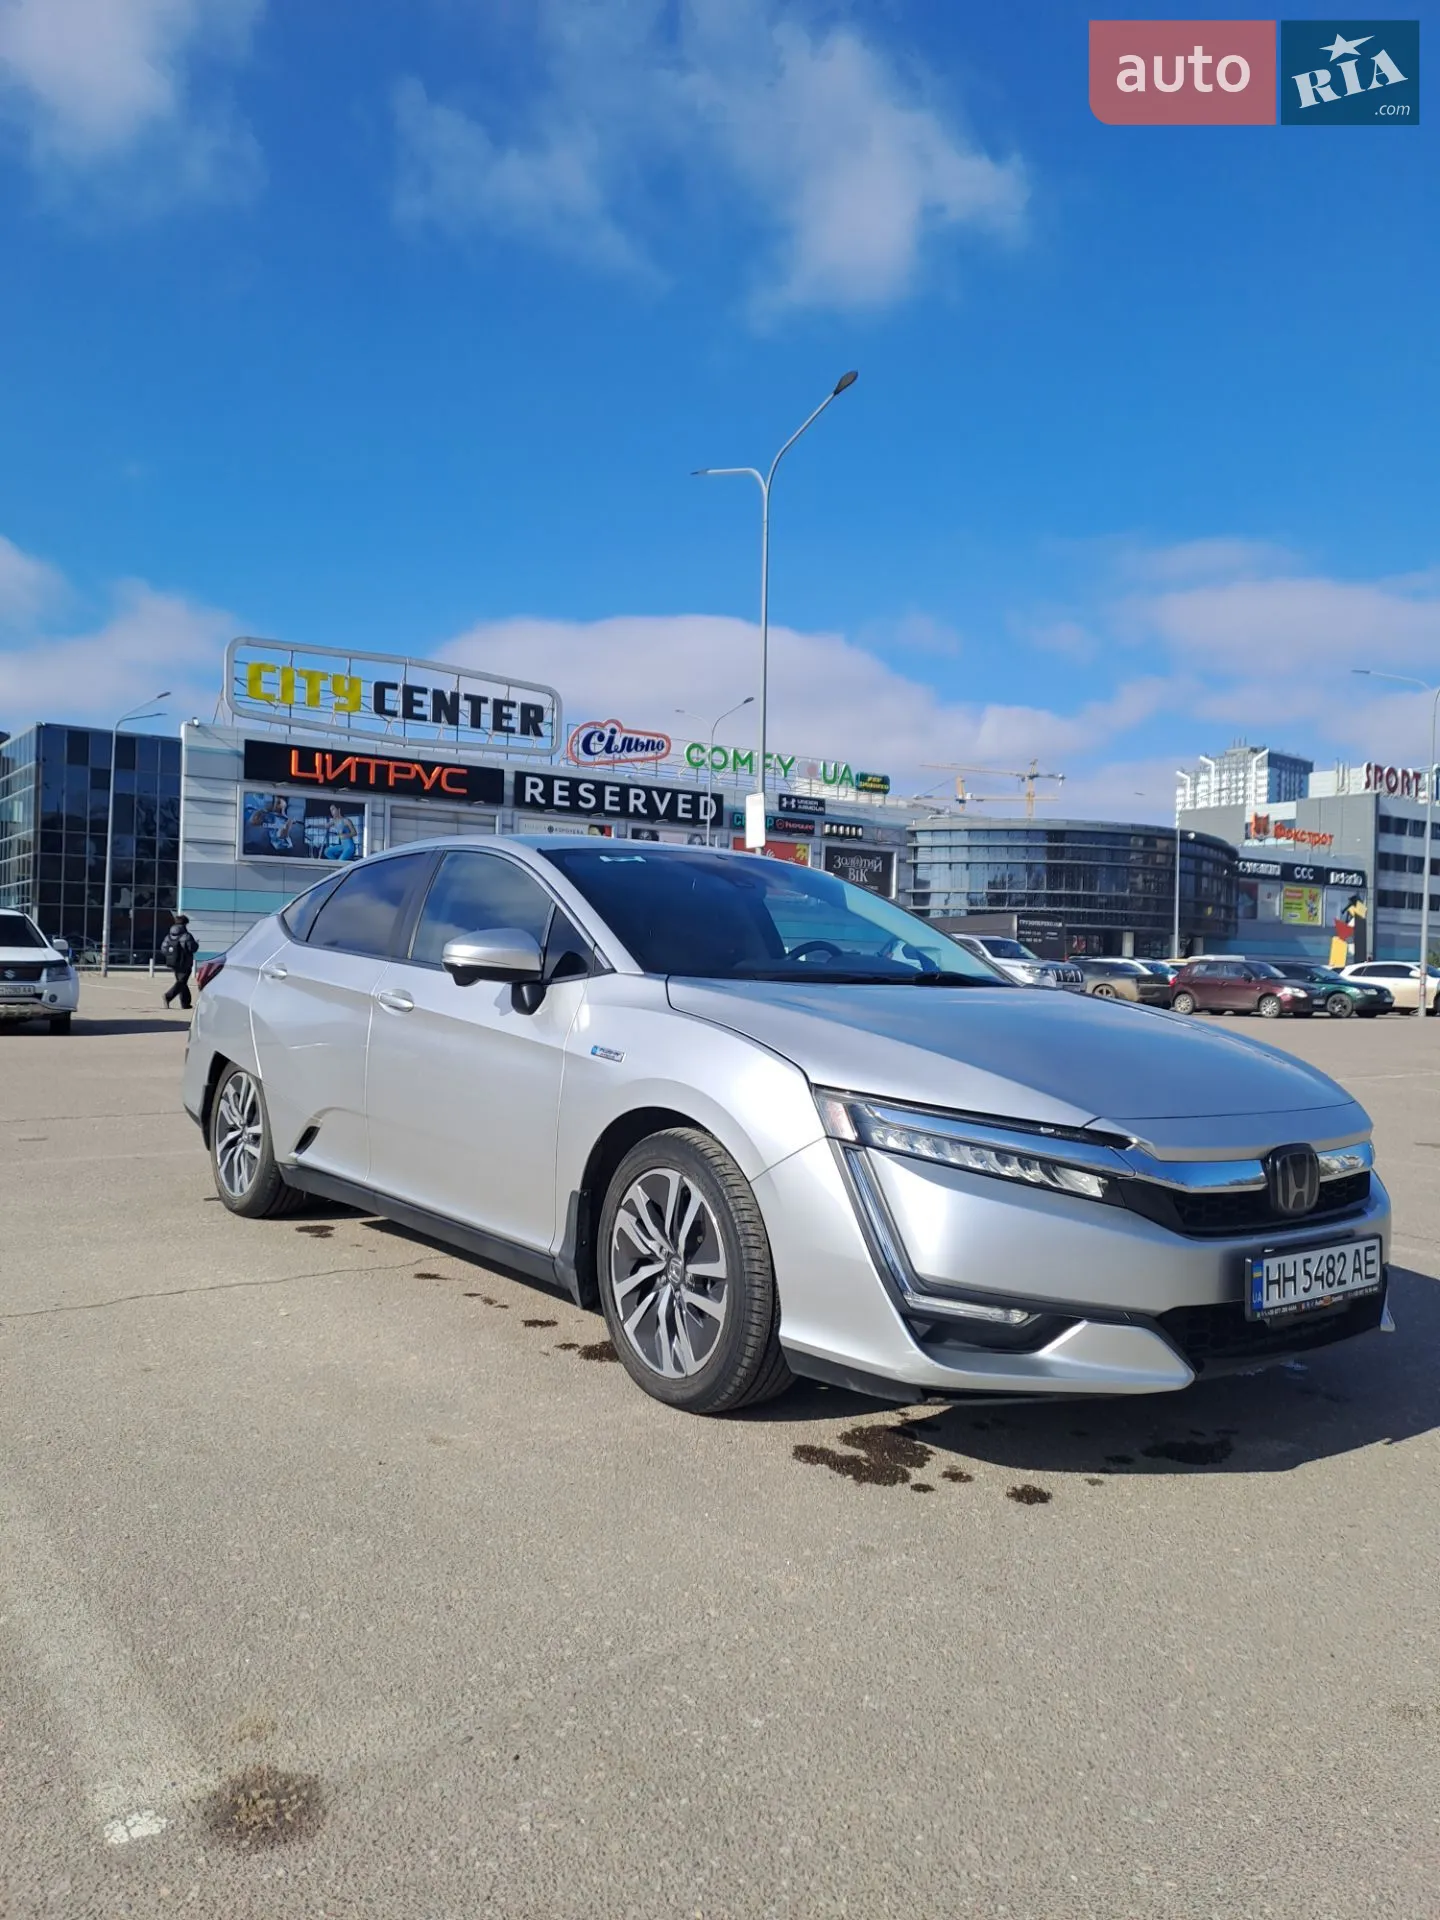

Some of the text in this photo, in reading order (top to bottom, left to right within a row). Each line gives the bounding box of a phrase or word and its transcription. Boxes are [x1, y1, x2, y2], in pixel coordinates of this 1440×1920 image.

[247, 662, 545, 738] CITY CENTER
[582, 727, 665, 757] Сільпо
[291, 749, 468, 794] ЦИТРУС
[1364, 762, 1422, 798] SPORT
[524, 776, 718, 821] RESERVED
[1252, 1290, 1262, 1303] UA
[1265, 1246, 1377, 1302] HH 5482 AE
